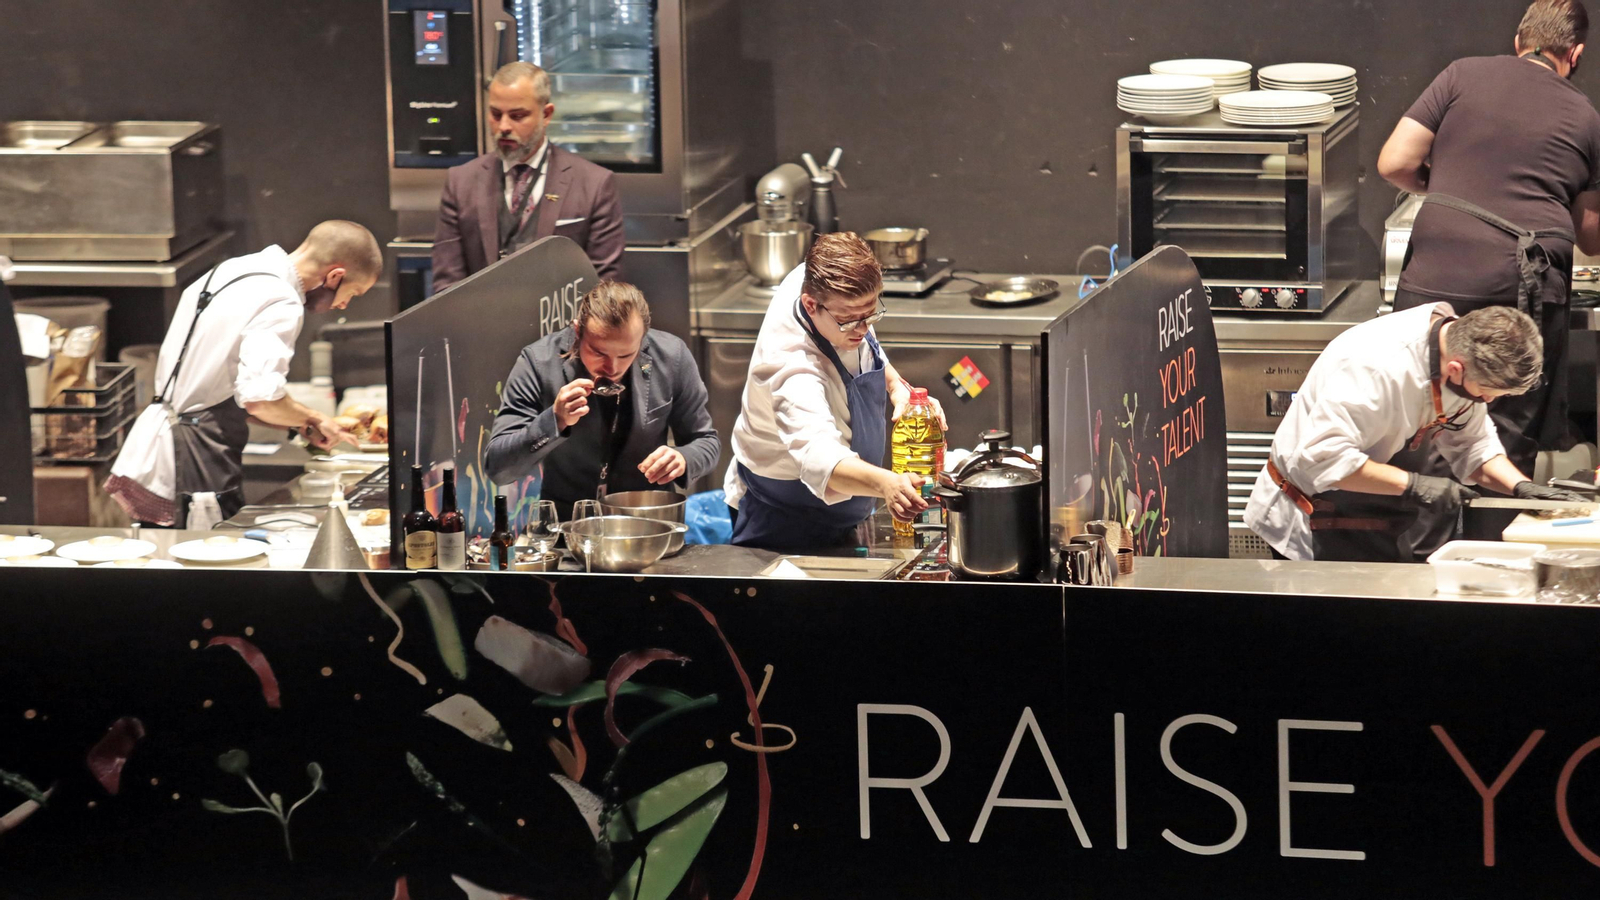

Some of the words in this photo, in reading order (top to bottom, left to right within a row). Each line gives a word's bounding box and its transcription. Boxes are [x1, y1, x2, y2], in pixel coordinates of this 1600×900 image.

[540, 277, 584, 338] RAISE
[1158, 288, 1194, 351] RAISE
[1159, 347, 1196, 408] YOUR
[1161, 396, 1206, 467] TALENT
[857, 703, 1366, 860] RAISE
[1430, 725, 1600, 868] Y
